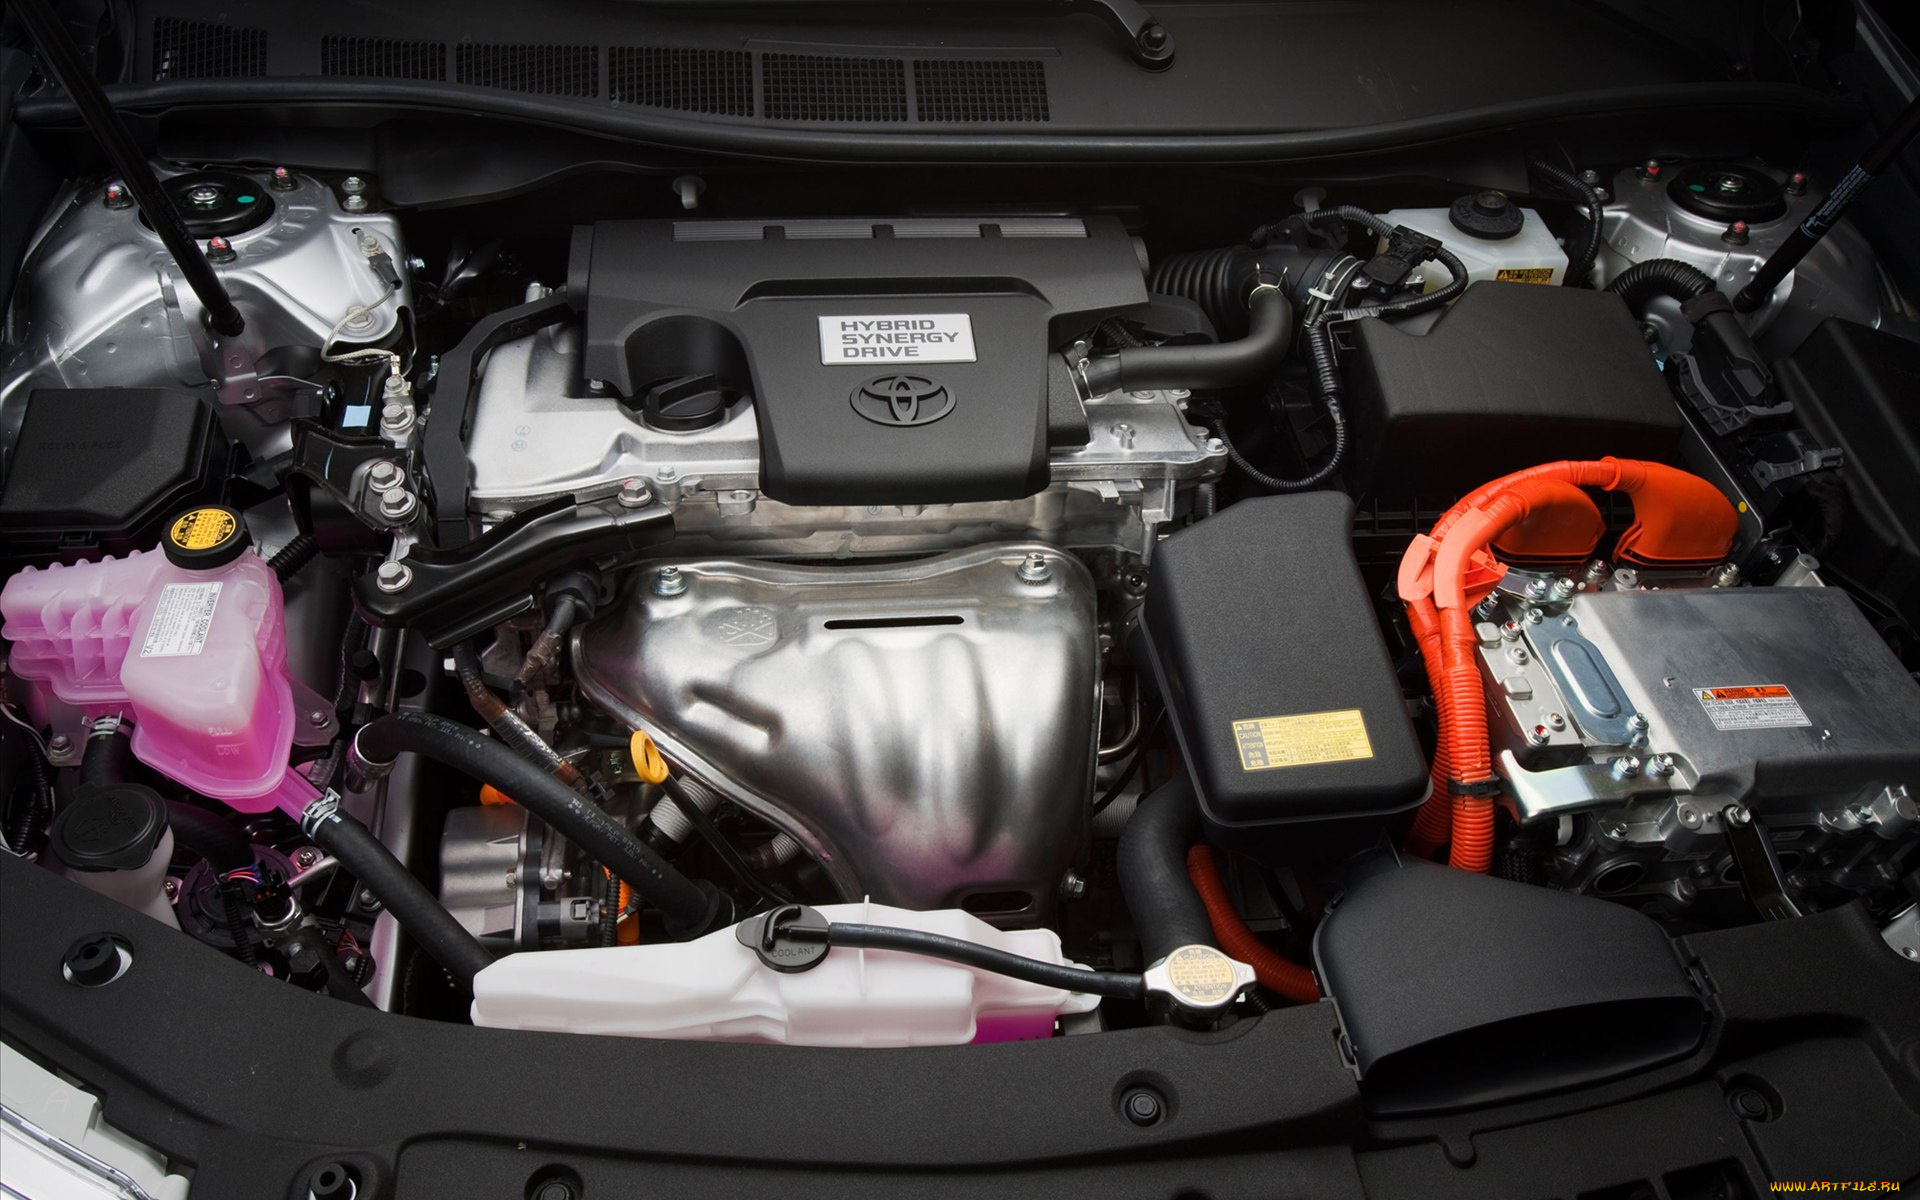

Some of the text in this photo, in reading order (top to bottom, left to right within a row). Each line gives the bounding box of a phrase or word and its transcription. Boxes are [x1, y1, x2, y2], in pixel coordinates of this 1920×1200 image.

[840, 319, 936, 332] HYBRID
[842, 331, 959, 345] SYNERGY
[843, 345, 920, 358] DRIVE
[771, 947, 816, 958] COOLANT
